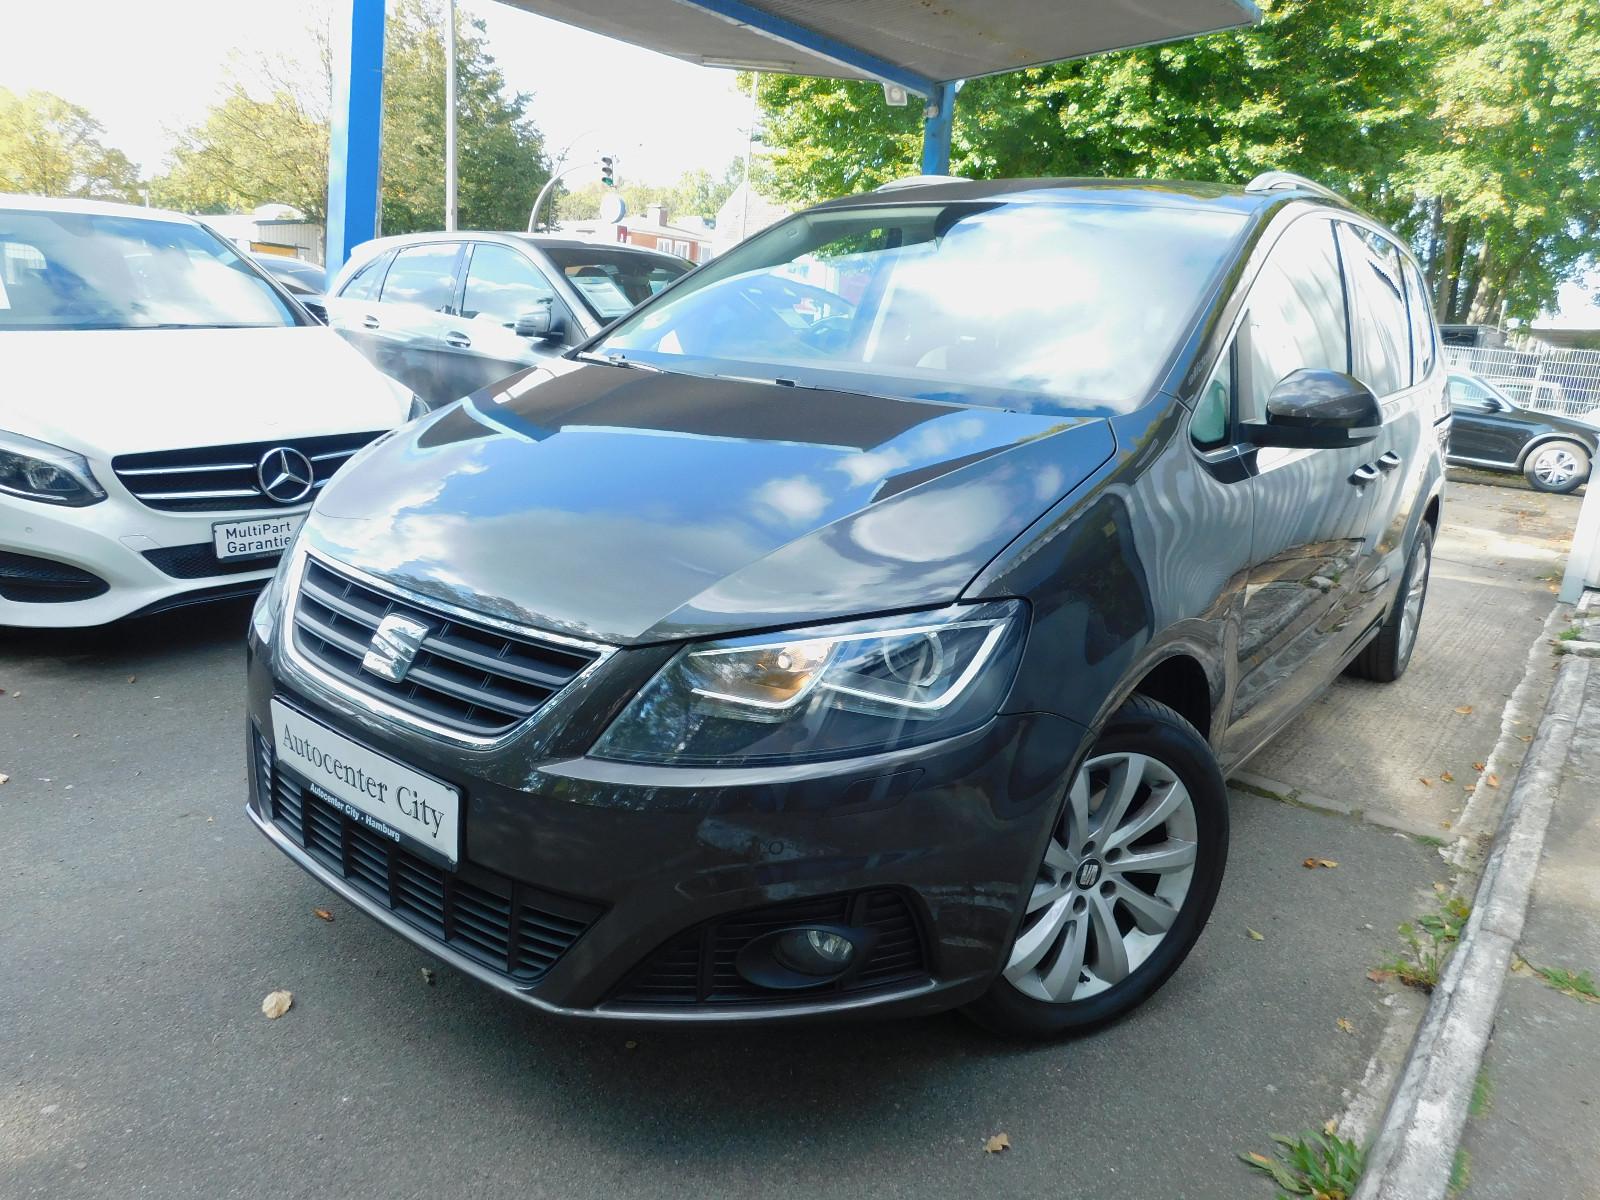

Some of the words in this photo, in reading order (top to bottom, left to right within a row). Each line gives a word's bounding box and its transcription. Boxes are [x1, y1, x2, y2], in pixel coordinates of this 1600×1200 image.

[226, 522, 291, 539] MultiPart
[227, 534, 292, 553] Garantie
[283, 723, 388, 804] Autocenter
[397, 785, 445, 838] City
[310, 783, 344, 810] Autocenter
[345, 803, 360, 821] City
[365, 815, 400, 842] Hamburg
